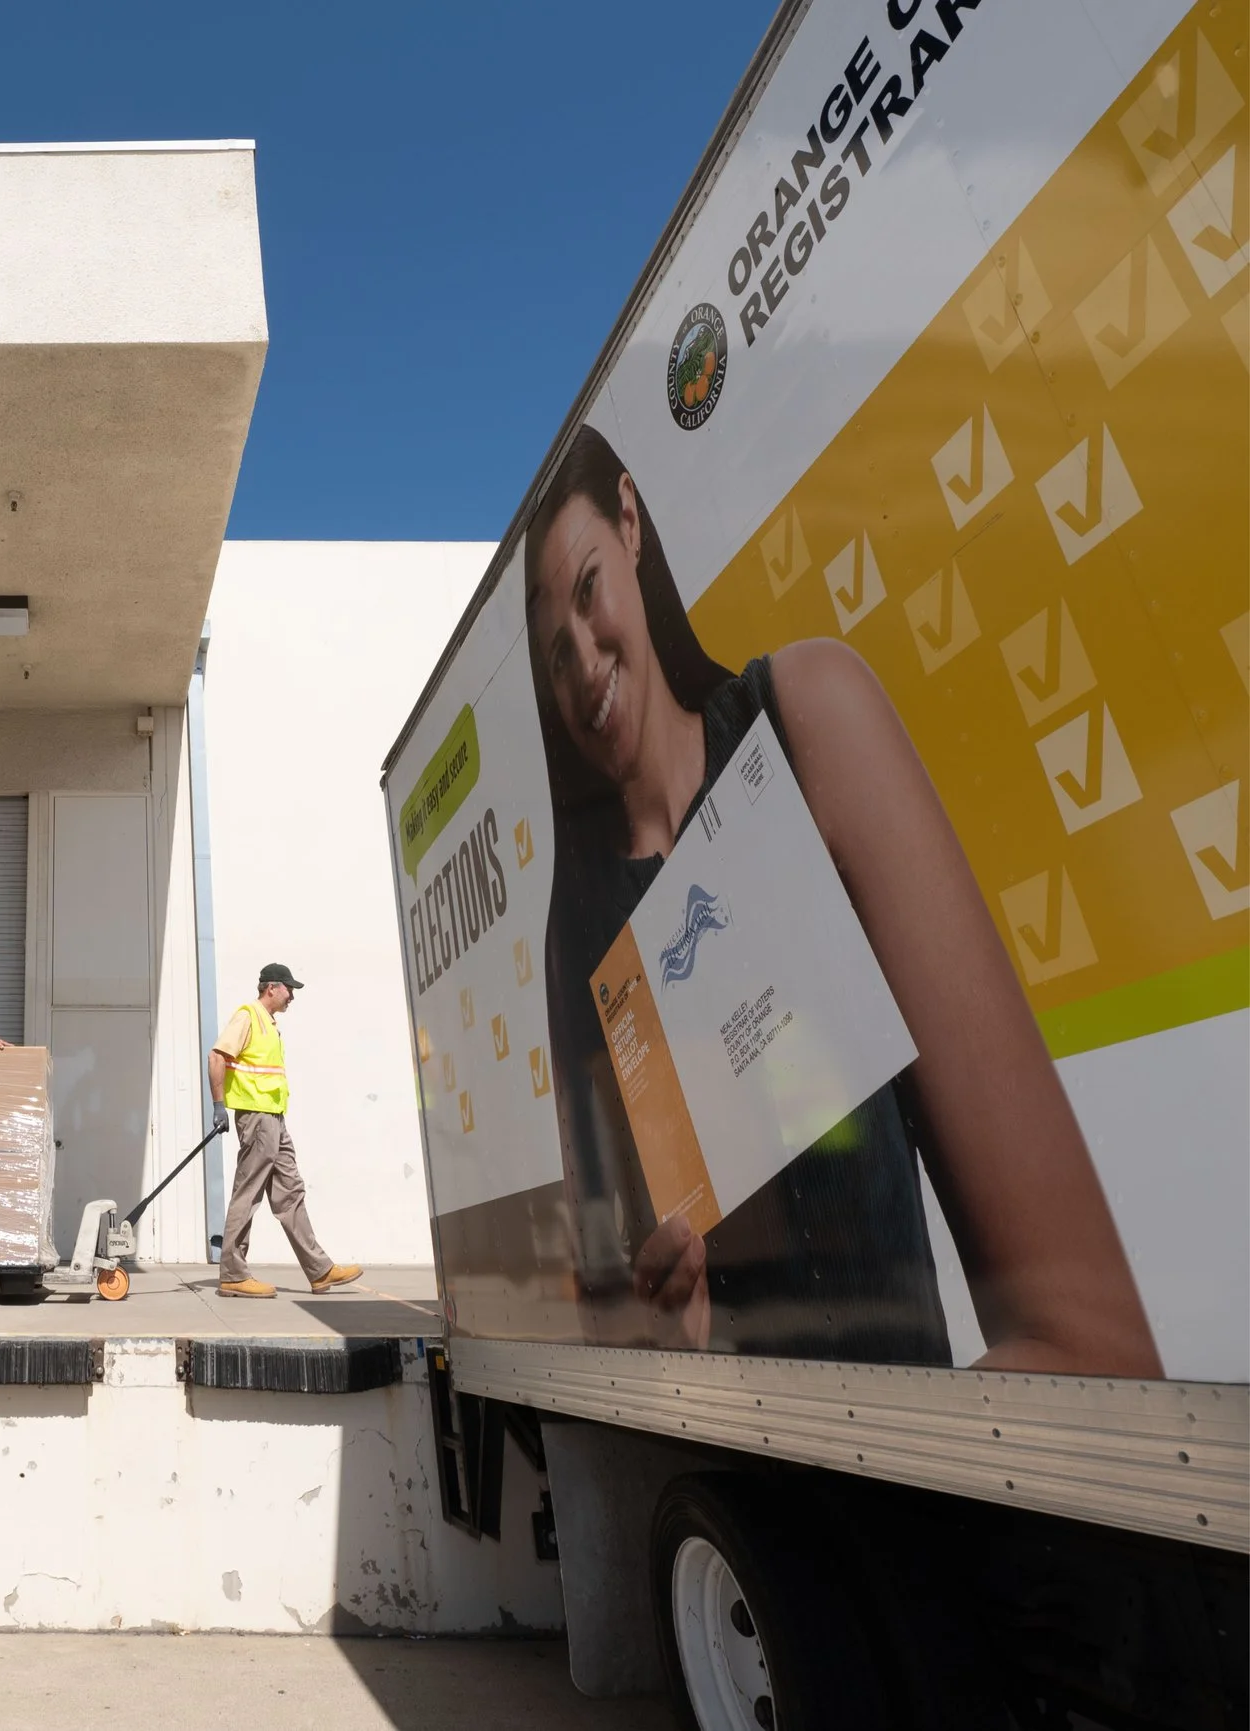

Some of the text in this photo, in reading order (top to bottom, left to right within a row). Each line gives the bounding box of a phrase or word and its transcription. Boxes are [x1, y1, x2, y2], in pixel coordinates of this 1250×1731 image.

[728, 35, 881, 296] ORANGE
[668, 340, 679, 410] COUNTY
[690, 306, 725, 340] ORANGE
[680, 354, 727, 428] CALIFORNIA
[405, 808, 424, 847] Making
[426, 783, 440, 816] easy
[438, 759, 450, 798] and
[449, 740, 468, 784] secure
[410, 807, 507, 997] ELECTIONS
[611, 1008, 635, 1044] OFFICIAL
[719, 999, 748, 1036] NEAL KELLEY
[723, 985, 775, 1047] REGISTRAR OF VOTERS
[727, 1002, 773, 1056] COUNTY OF ORANGE
[614, 1023, 636, 1057] RETURN
[618, 1037, 639, 1069] BALLOT
[621, 1040, 650, 1081] ENVELOPE
[734, 1058, 750, 1078] SANTA
[760, 1038, 768, 1051] CA
[739, 1041, 751, 1058] BOX
